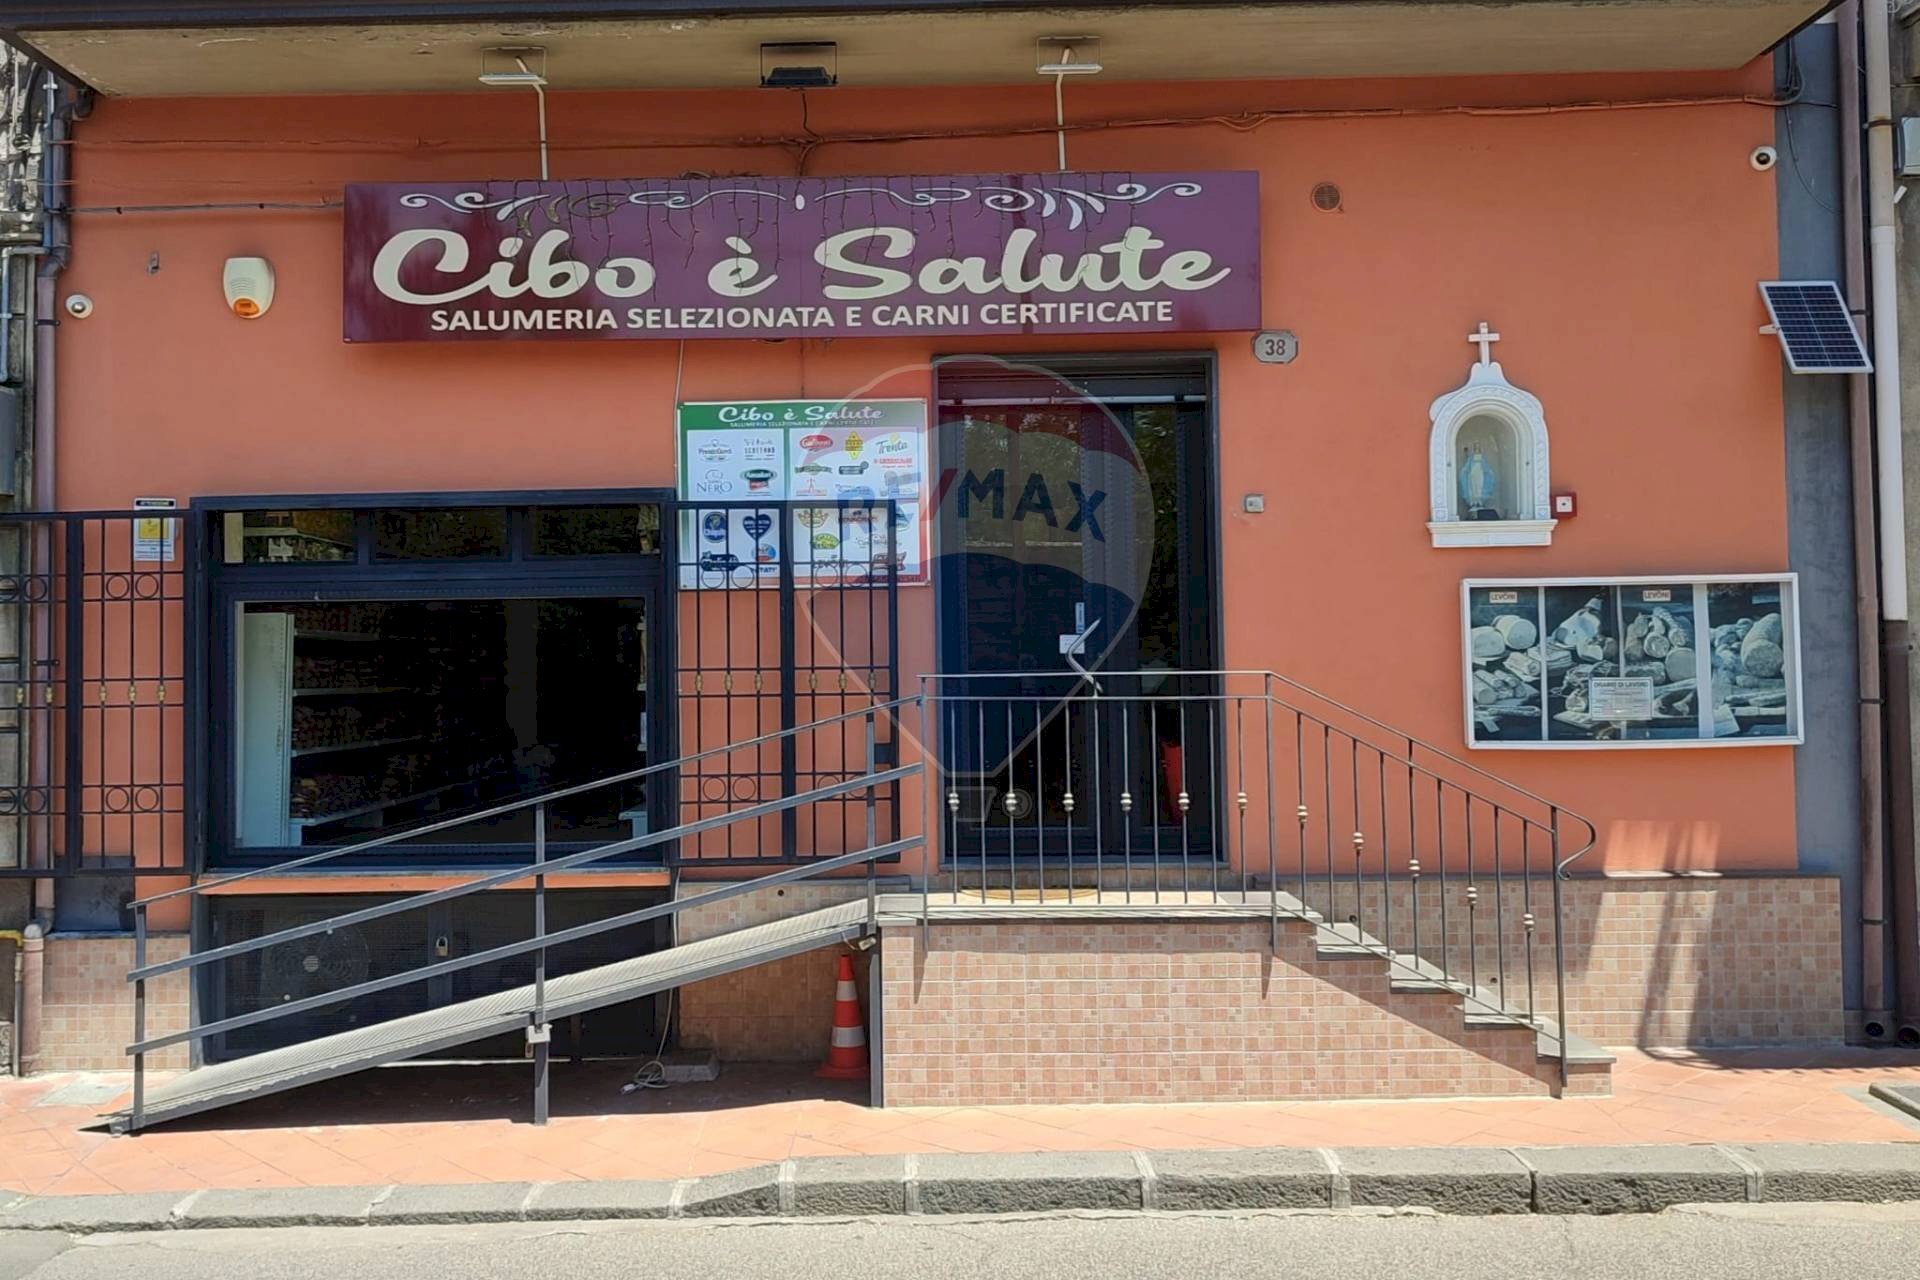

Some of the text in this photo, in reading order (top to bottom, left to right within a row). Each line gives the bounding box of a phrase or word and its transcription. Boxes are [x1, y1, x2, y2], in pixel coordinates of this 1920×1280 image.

[372, 226, 1232, 305] Cibo è Salute
[430, 300, 1174, 332] SALUMERIA SELEZIONATA E CARNI CERTIFICATE
[1265, 338, 1286, 356] 38
[718, 404, 884, 422] Cibo è Salute
